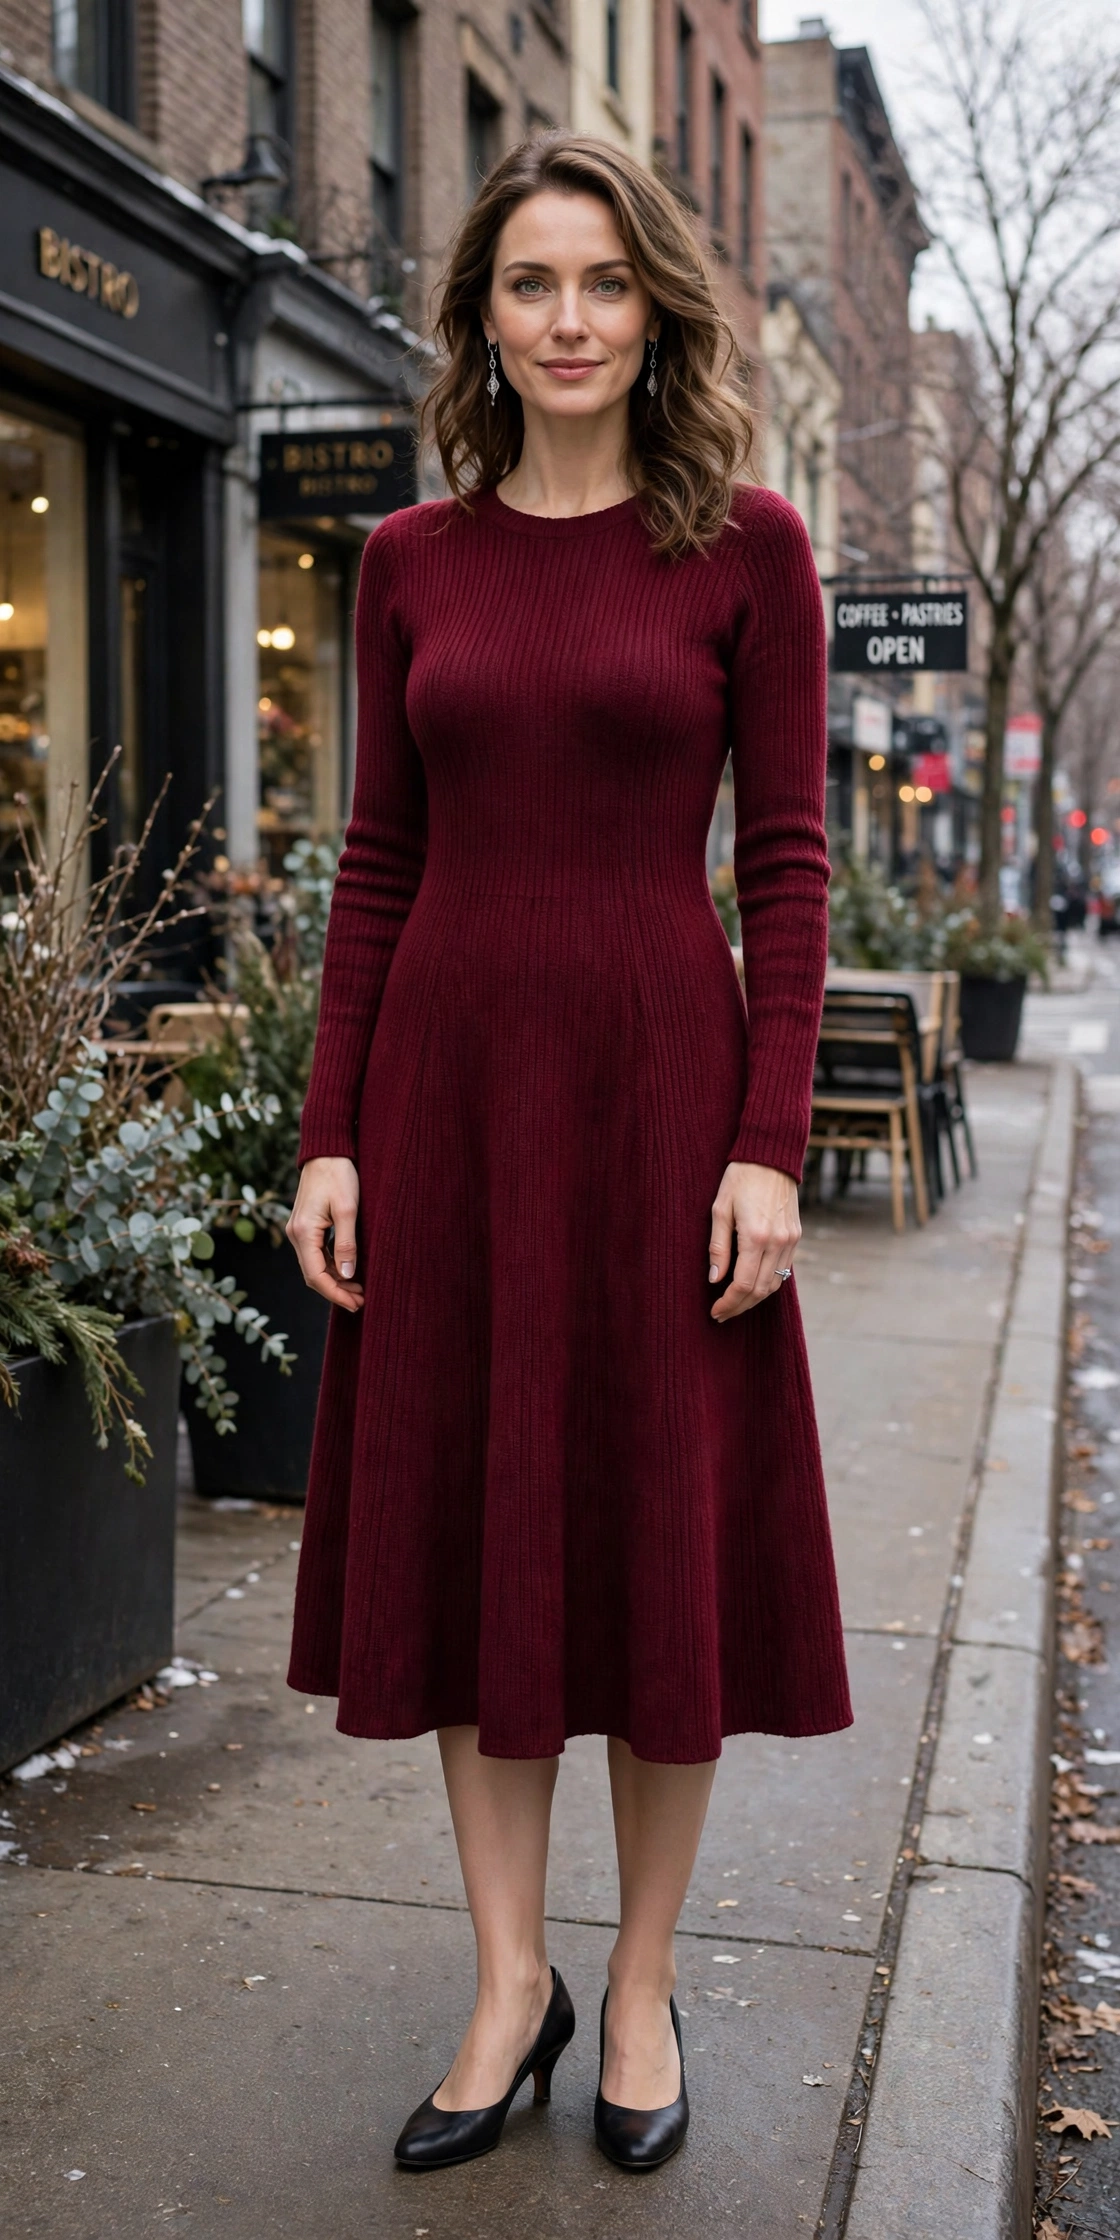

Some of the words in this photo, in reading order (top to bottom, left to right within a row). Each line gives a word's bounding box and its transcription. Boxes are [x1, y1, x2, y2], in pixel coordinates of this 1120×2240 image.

[38, 226, 140, 319] BISTRO
[282, 441, 395, 472] BISTRO
[837, 603, 888, 628] COFFEE
[901, 602, 963, 627] PASTRIES
[866, 637, 925, 665] OPEN
